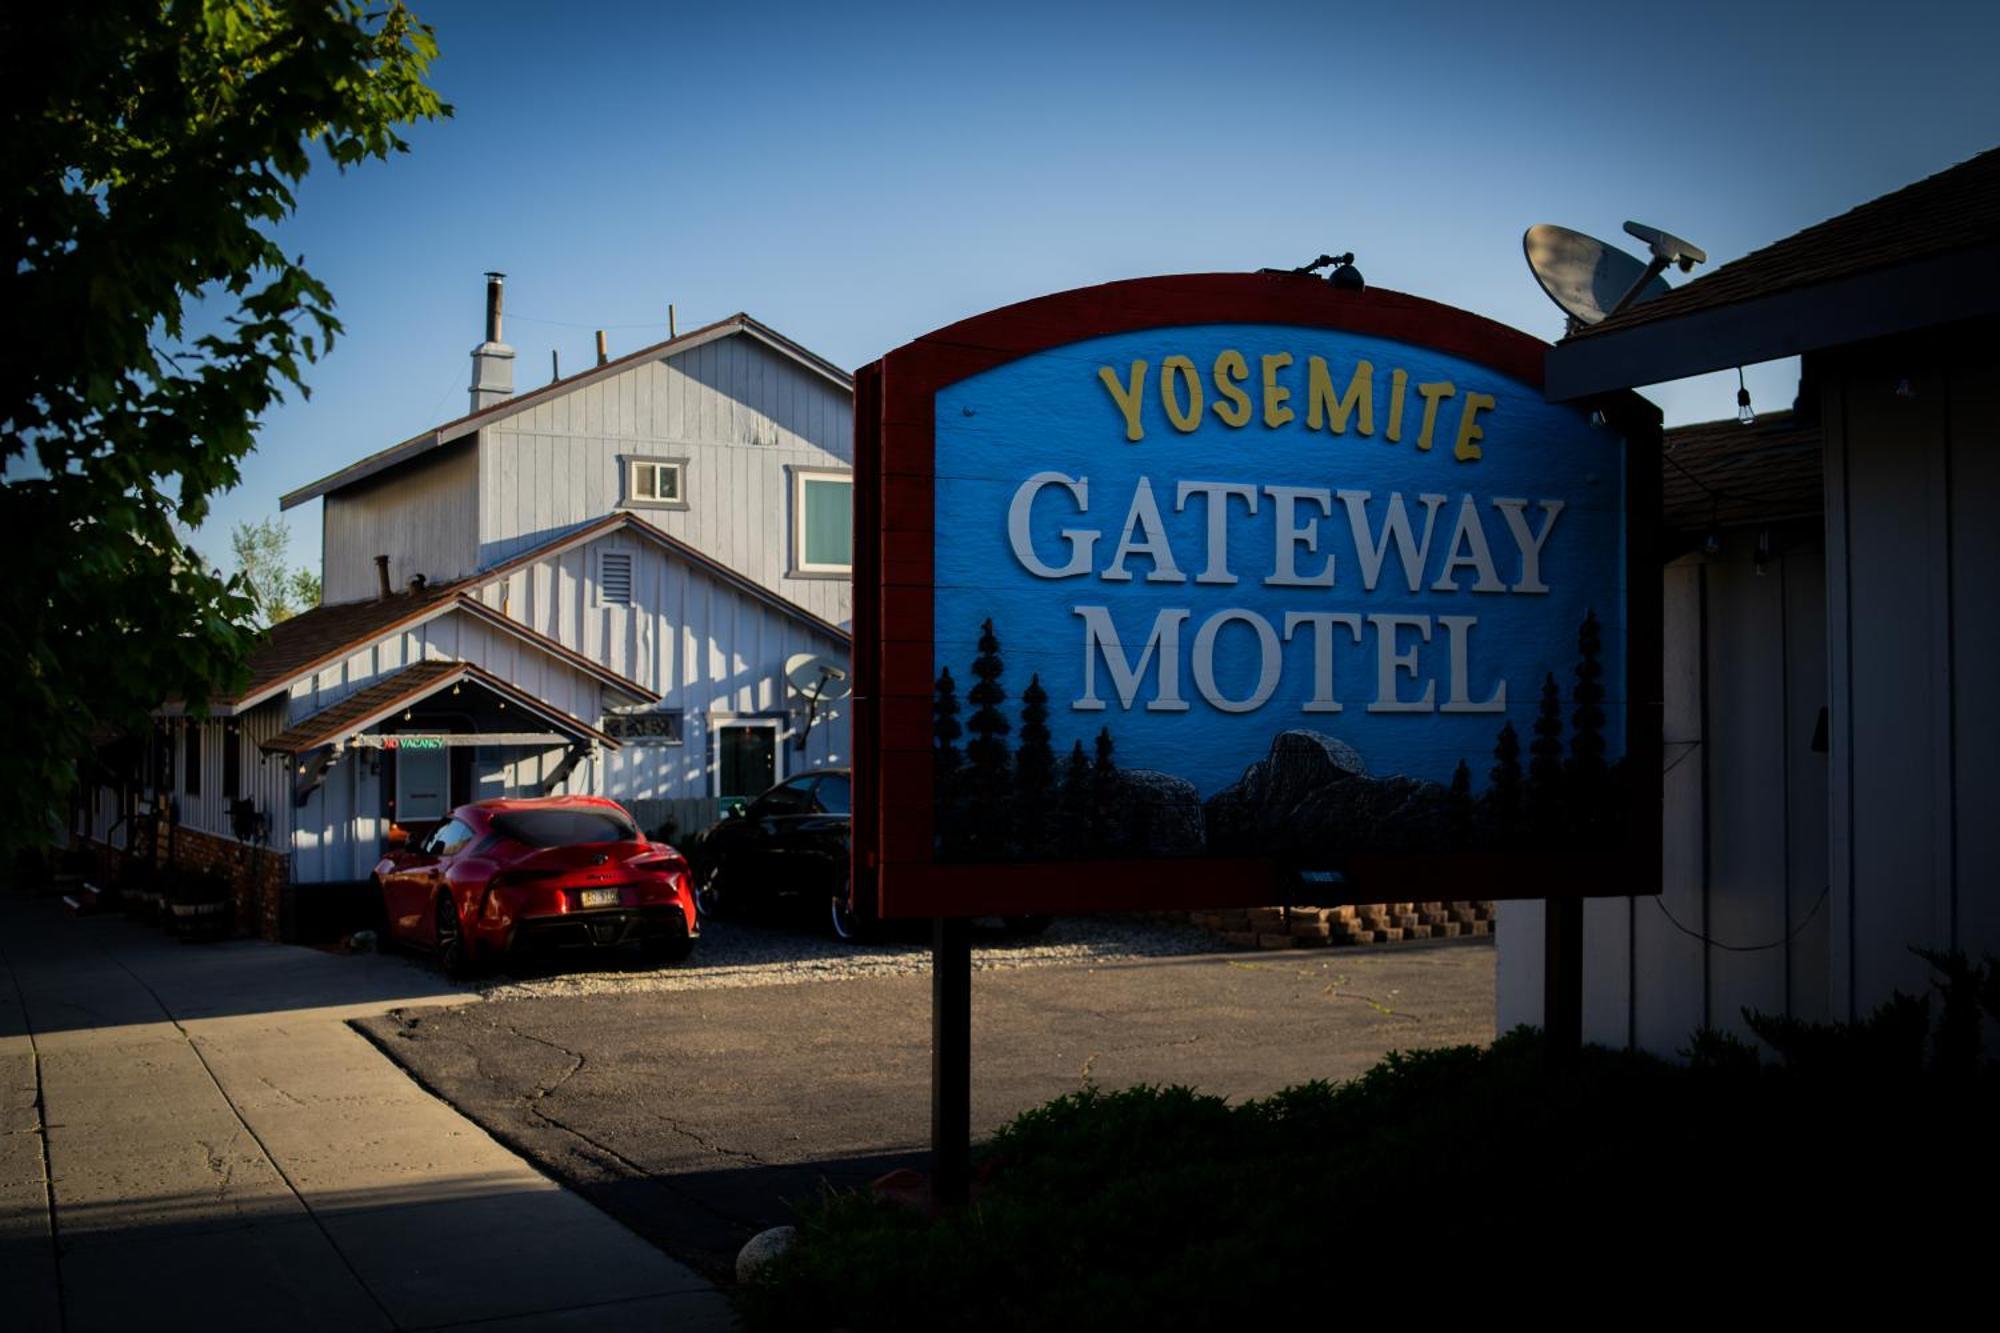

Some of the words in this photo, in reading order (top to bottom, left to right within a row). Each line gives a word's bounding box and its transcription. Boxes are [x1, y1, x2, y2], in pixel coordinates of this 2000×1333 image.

[1099, 349, 1496, 460] YOSEMITE
[1008, 471, 1565, 594] GATEWAY
[1072, 605, 1507, 714] MOTEL
[384, 737, 398, 749] NO
[400, 737, 443, 749] VACANCY
